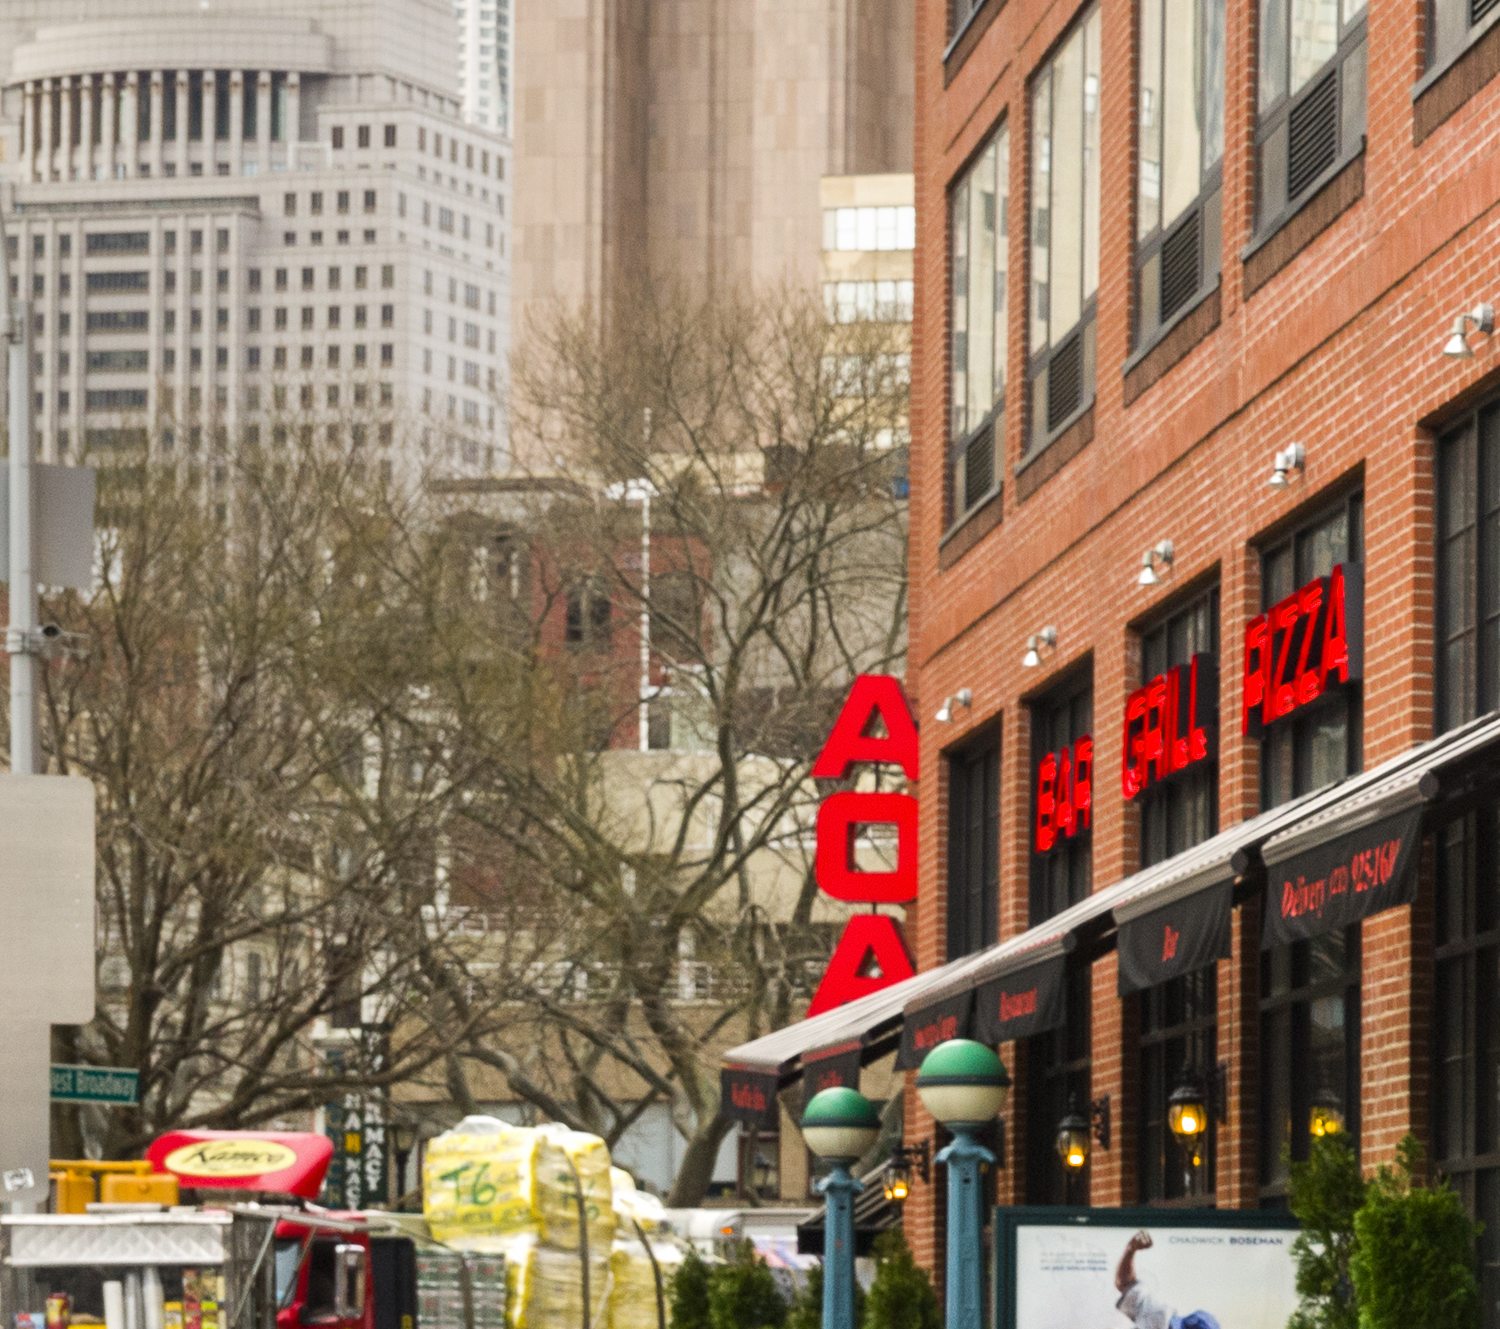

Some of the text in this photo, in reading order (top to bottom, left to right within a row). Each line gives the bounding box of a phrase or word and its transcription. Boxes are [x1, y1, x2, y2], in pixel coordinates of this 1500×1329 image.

[1242, 563, 1349, 737] PIZZA
[1122, 652, 1208, 801] GRILL
[1034, 733, 1094, 854] BAR
[1280, 876, 1326, 918] Delivery
[51, 1069, 137, 1103] est Broadway
[438, 1161, 498, 1207] T6
[1168, 1234, 1284, 1246] CHADWICK BOSEMAN
